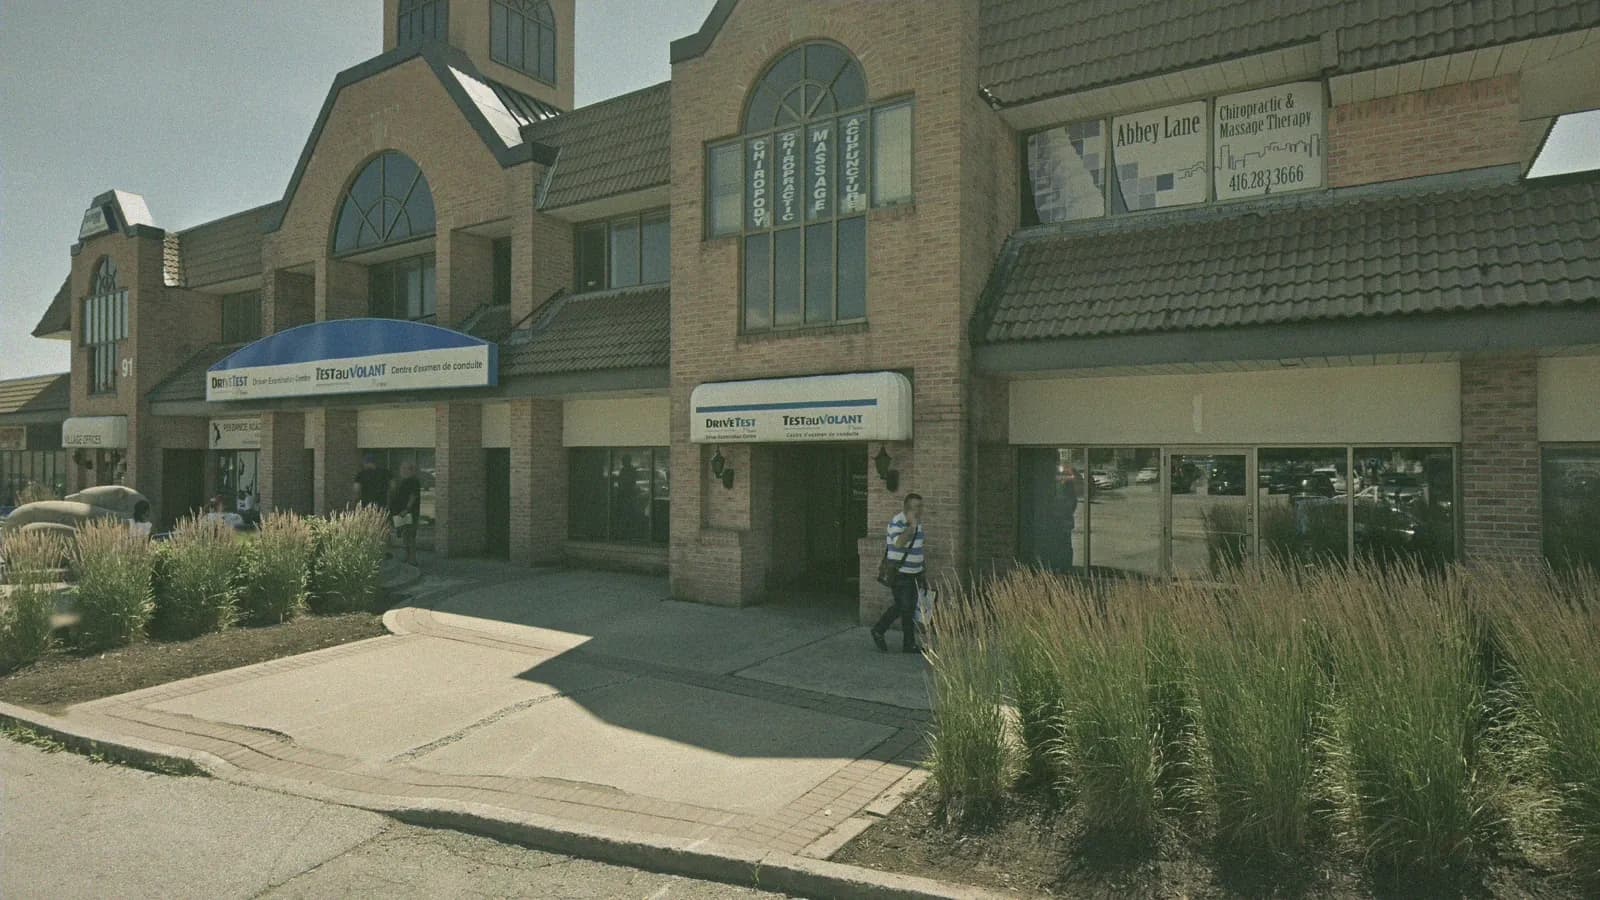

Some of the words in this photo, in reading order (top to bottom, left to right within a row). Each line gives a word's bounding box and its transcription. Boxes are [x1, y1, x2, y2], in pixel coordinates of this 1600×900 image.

[1219, 97, 1282, 120] Chiropractic
[1285, 93, 1294, 108] &
[1117, 121, 1159, 147] Abbey
[1164, 115, 1200, 138] Lane
[1220, 120, 1264, 138] Massage
[1266, 111, 1311, 130] Therapy
[753, 140, 766, 227] CHIROPODY
[782, 133, 796, 221] CHIROPRACTIC
[813, 129, 829, 211] MASSAGE
[122, 357, 133, 377] 91
[391, 366, 412, 374] Centre
[442, 362, 451, 370] de
[453, 360, 483, 370] conduite
